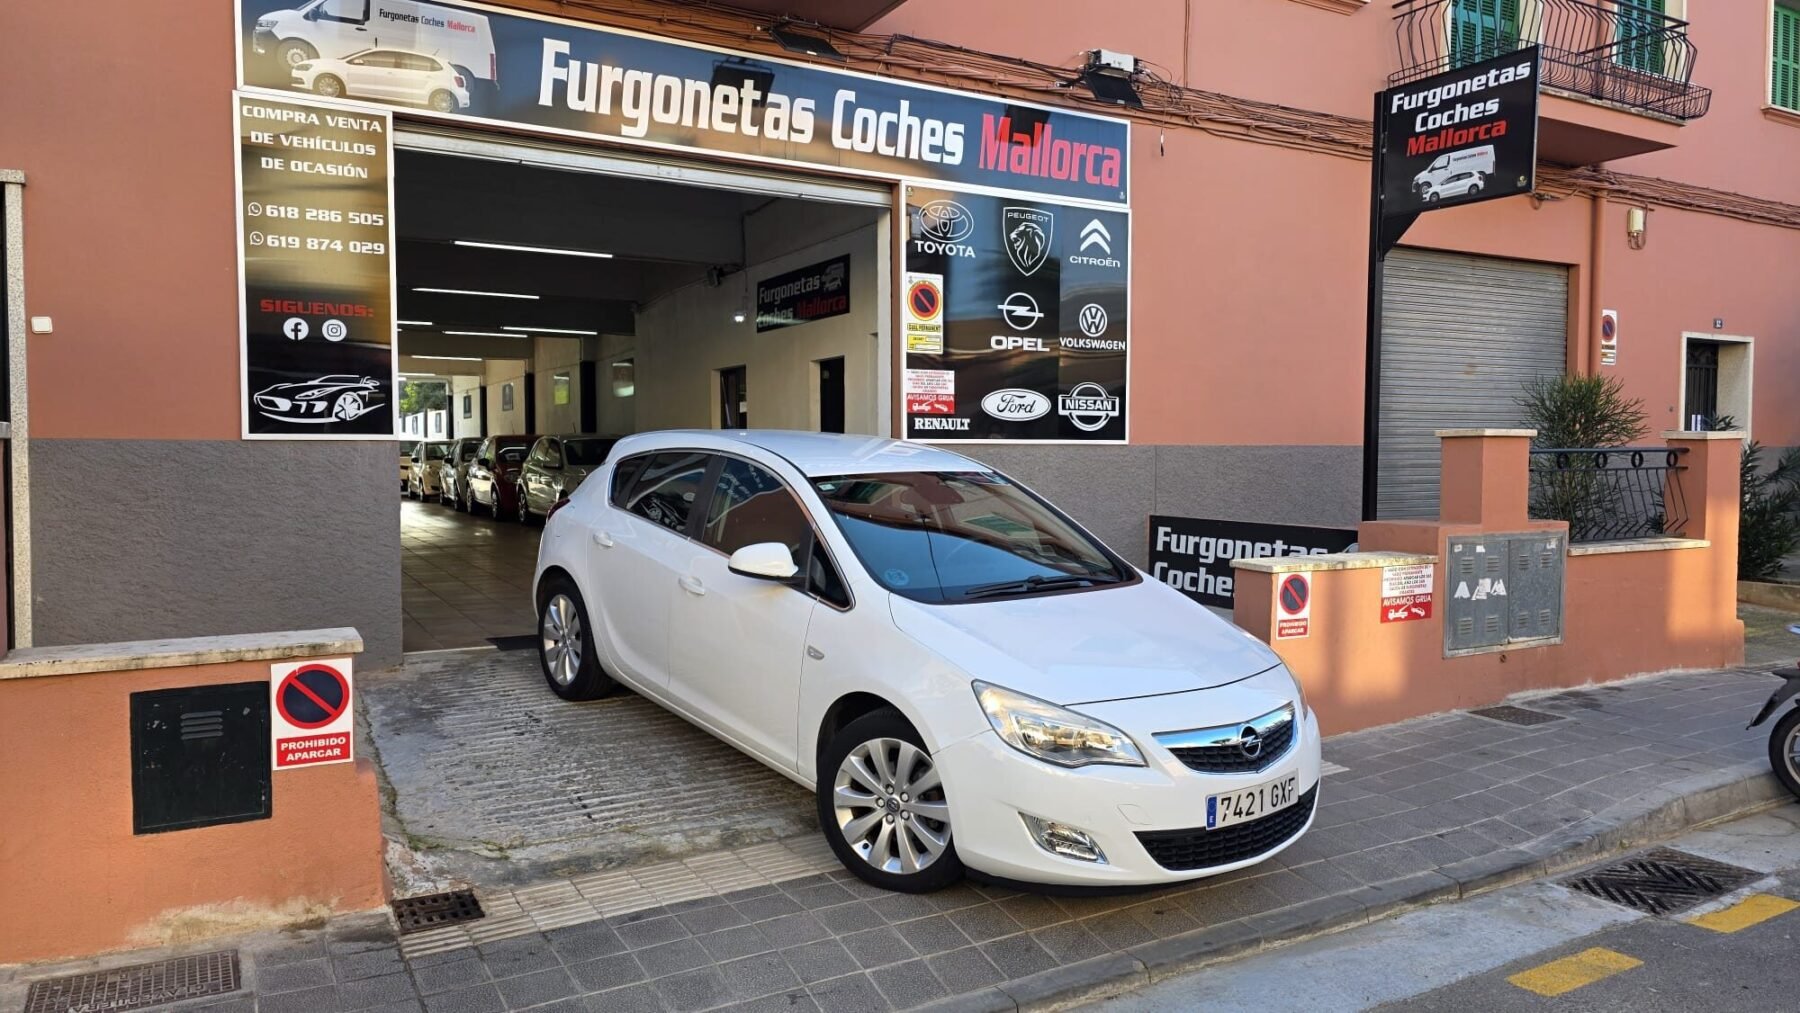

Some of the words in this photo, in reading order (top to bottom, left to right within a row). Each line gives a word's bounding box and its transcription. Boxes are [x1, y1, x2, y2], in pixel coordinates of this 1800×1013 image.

[379, 8, 419, 24] Furgonetas
[421, 16, 445, 28] Coches
[447, 19, 476, 33] Mallorca
[1391, 62, 1531, 114] Furgonetas
[242, 105, 320, 126] COMPRA
[326, 115, 383, 133] VENTA
[538, 37, 816, 145] Furgonetas
[831, 89, 966, 166] Coches
[979, 112, 1122, 188] Mallorca
[1415, 98, 1500, 133] Coches
[250, 131, 274, 144] DE
[280, 134, 376, 156] VEHÍCULOS
[1406, 120, 1507, 157] Mallorca
[261, 157, 285, 170] DE
[290, 160, 368, 179] OCASIÓN
[266, 205, 299, 220] 618
[305, 208, 342, 223] 286
[349, 212, 385, 226] 505
[1007, 211, 1050, 223] PEUGEOT
[266, 235, 300, 249] 619
[306, 238, 343, 252] 874
[349, 241, 385, 255] 029
[914, 240, 976, 259] TOYOTA
[759, 275, 821, 306] Furgonetas
[260, 299, 374, 317] SIGUENOS:
[990, 335, 1050, 352] OPEL
[1059, 336, 1126, 351] VOLKSWAGEN
[996, 395, 1036, 414] Ford
[1065, 399, 1112, 412] NISSAN
[914, 417, 971, 431] RENAULT
[1154, 561, 1235, 598] Coche
[1383, 595, 1415, 607] AVISAMOS
[1415, 595, 1432, 604] GRUA
[281, 736, 346, 751] PROHIBIDO
[286, 748, 341, 762] APARCAR
[1220, 788, 1264, 822] 7421
[1271, 777, 1295, 807] GXF
